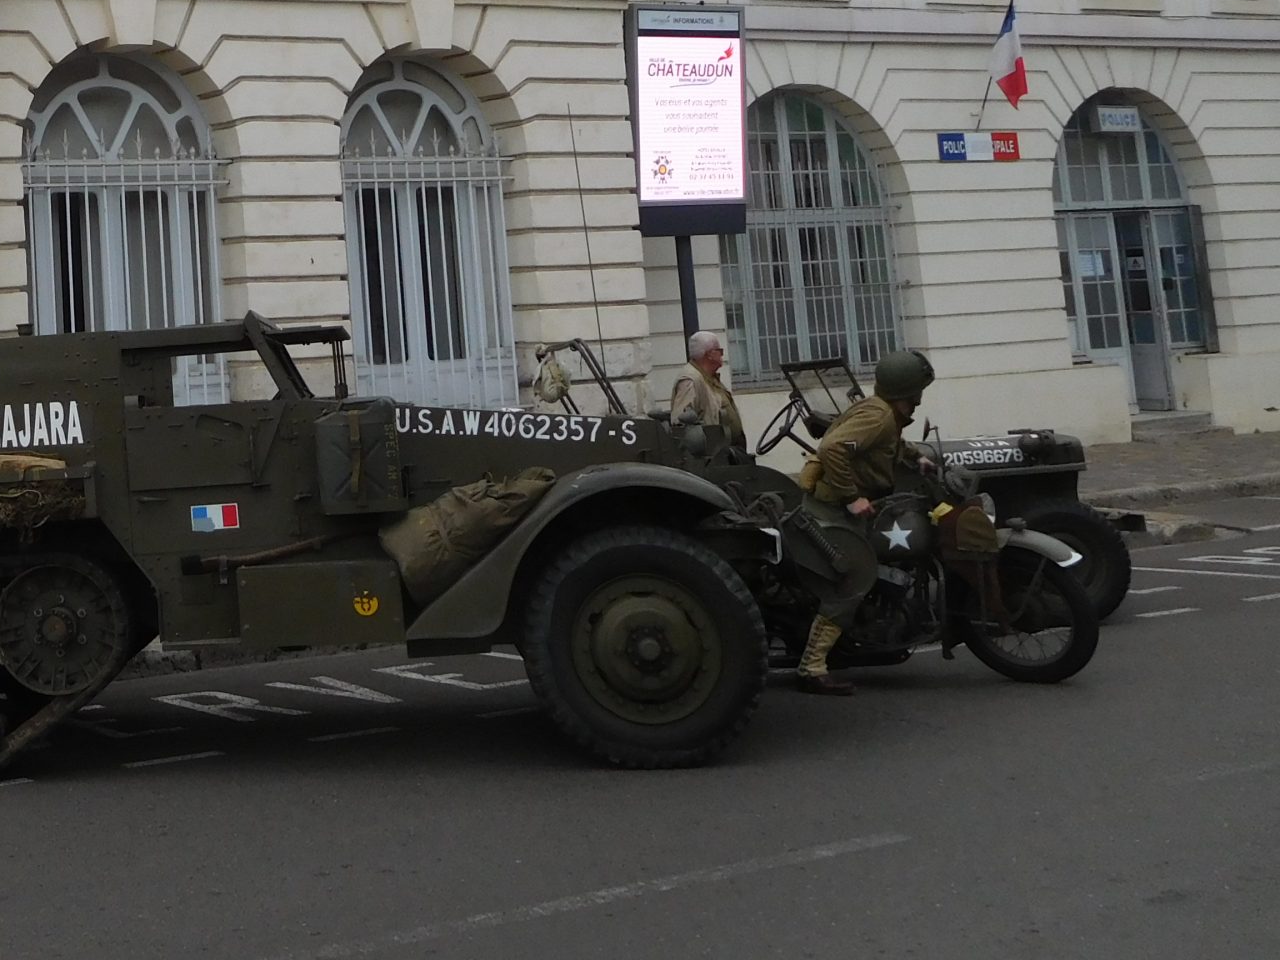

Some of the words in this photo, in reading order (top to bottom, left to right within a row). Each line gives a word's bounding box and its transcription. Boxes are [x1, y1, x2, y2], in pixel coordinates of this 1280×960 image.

[672, 17, 714, 25] INFORMATIONS
[647, 60, 734, 78] CHÂTEAUDUN
[1101, 111, 1137, 128] POLICE
[942, 140, 966, 154] POLIC
[942, 448, 1024, 467] 20596678
